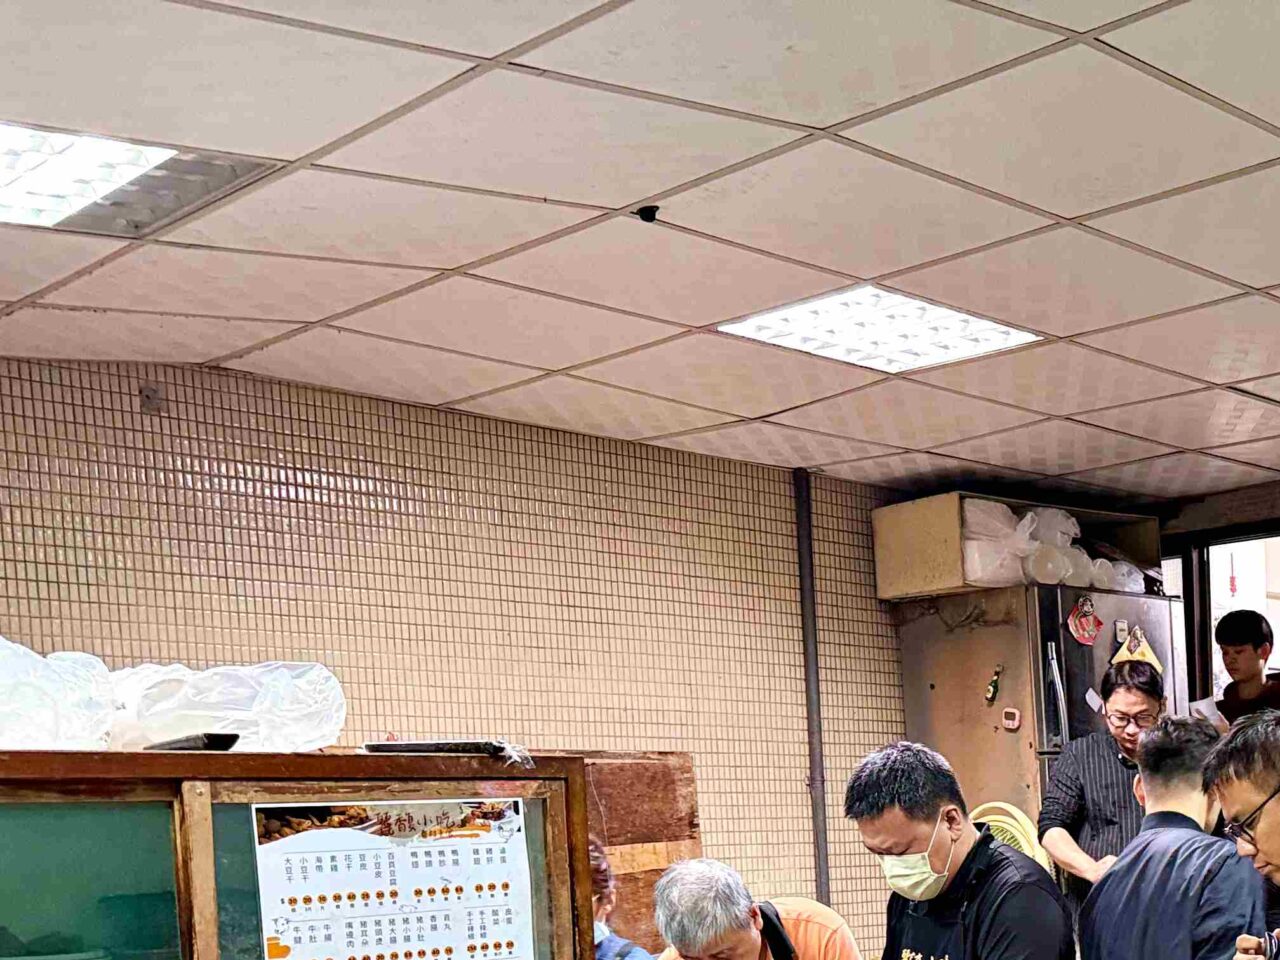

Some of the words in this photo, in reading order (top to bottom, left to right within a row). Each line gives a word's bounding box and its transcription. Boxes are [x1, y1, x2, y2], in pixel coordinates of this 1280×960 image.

[284, 857, 294, 884] 大豆干
[300, 857, 309, 883] 小豆干
[373, 853, 382, 878] 小豆皮
